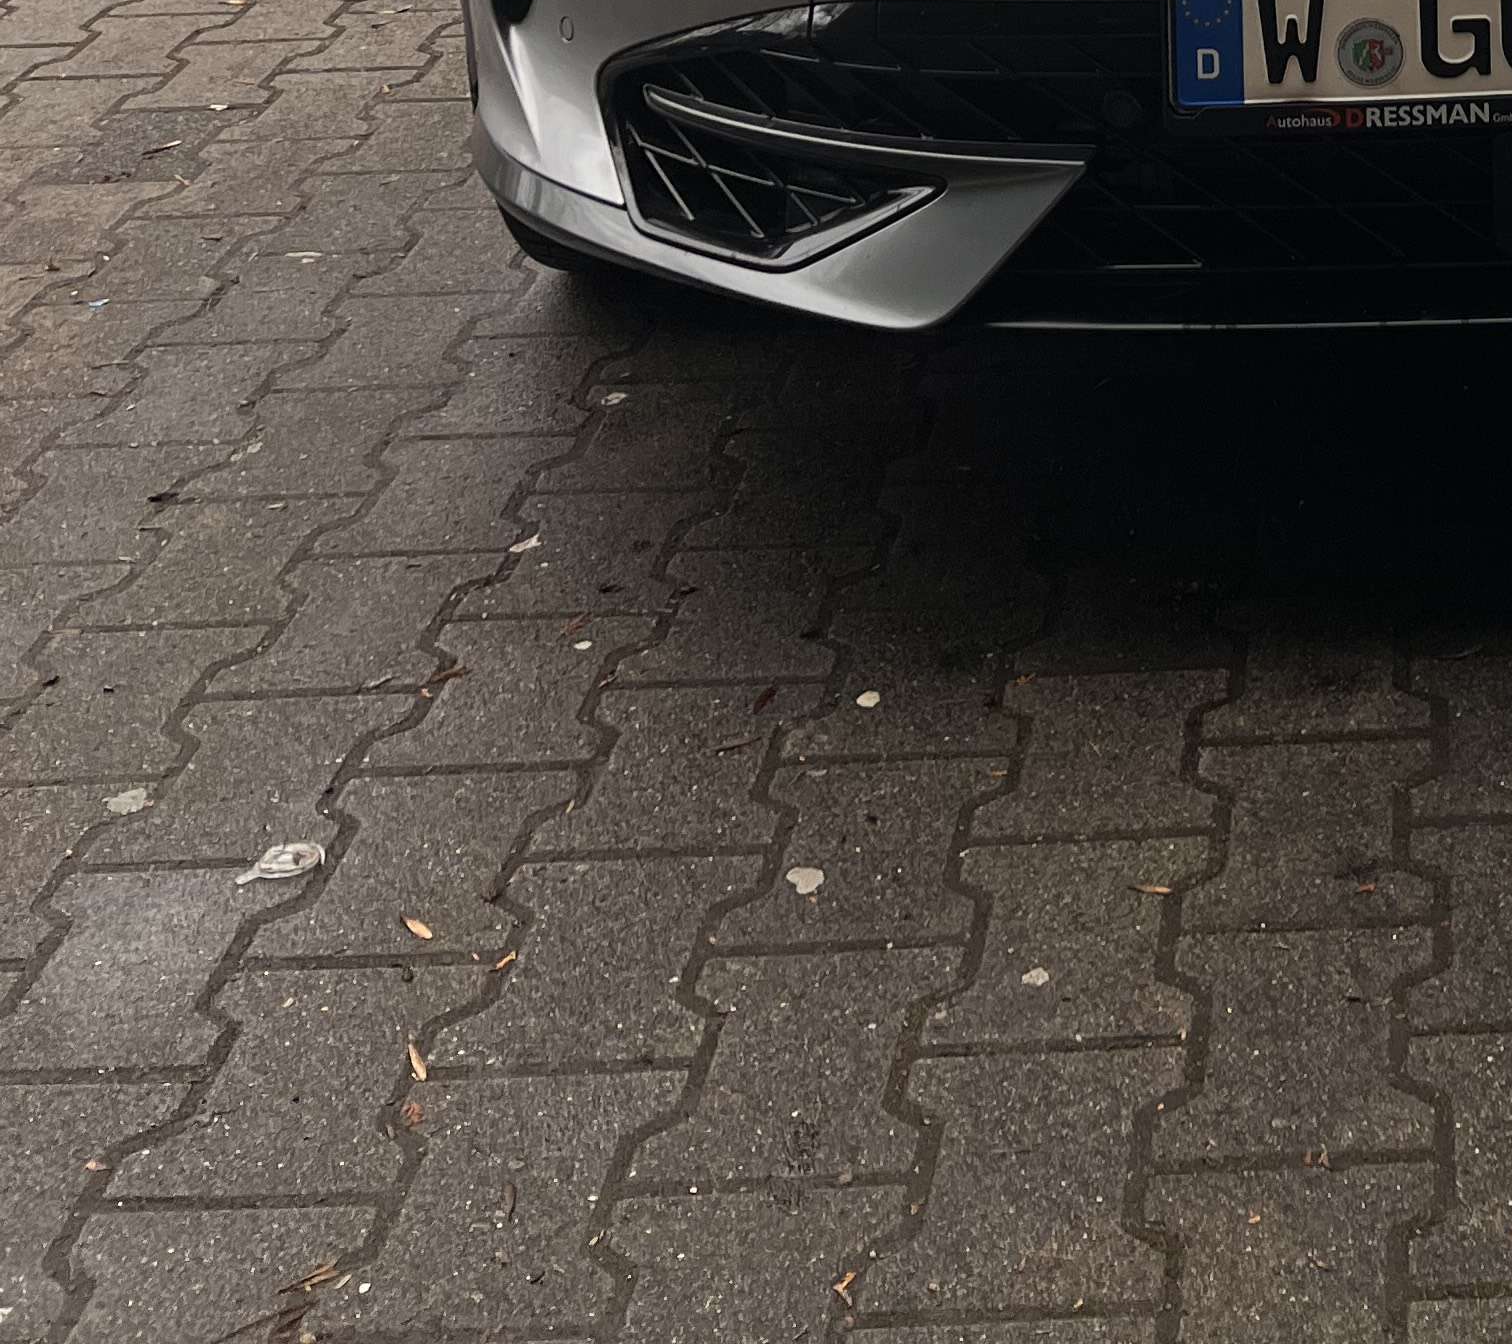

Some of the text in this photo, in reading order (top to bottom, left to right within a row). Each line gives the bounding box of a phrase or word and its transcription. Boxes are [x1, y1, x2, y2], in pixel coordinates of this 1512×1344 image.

[1197, 47, 1221, 80] D
[1265, 113, 1333, 129] Autohaus
[1345, 102, 1491, 128] DRESSMAN
